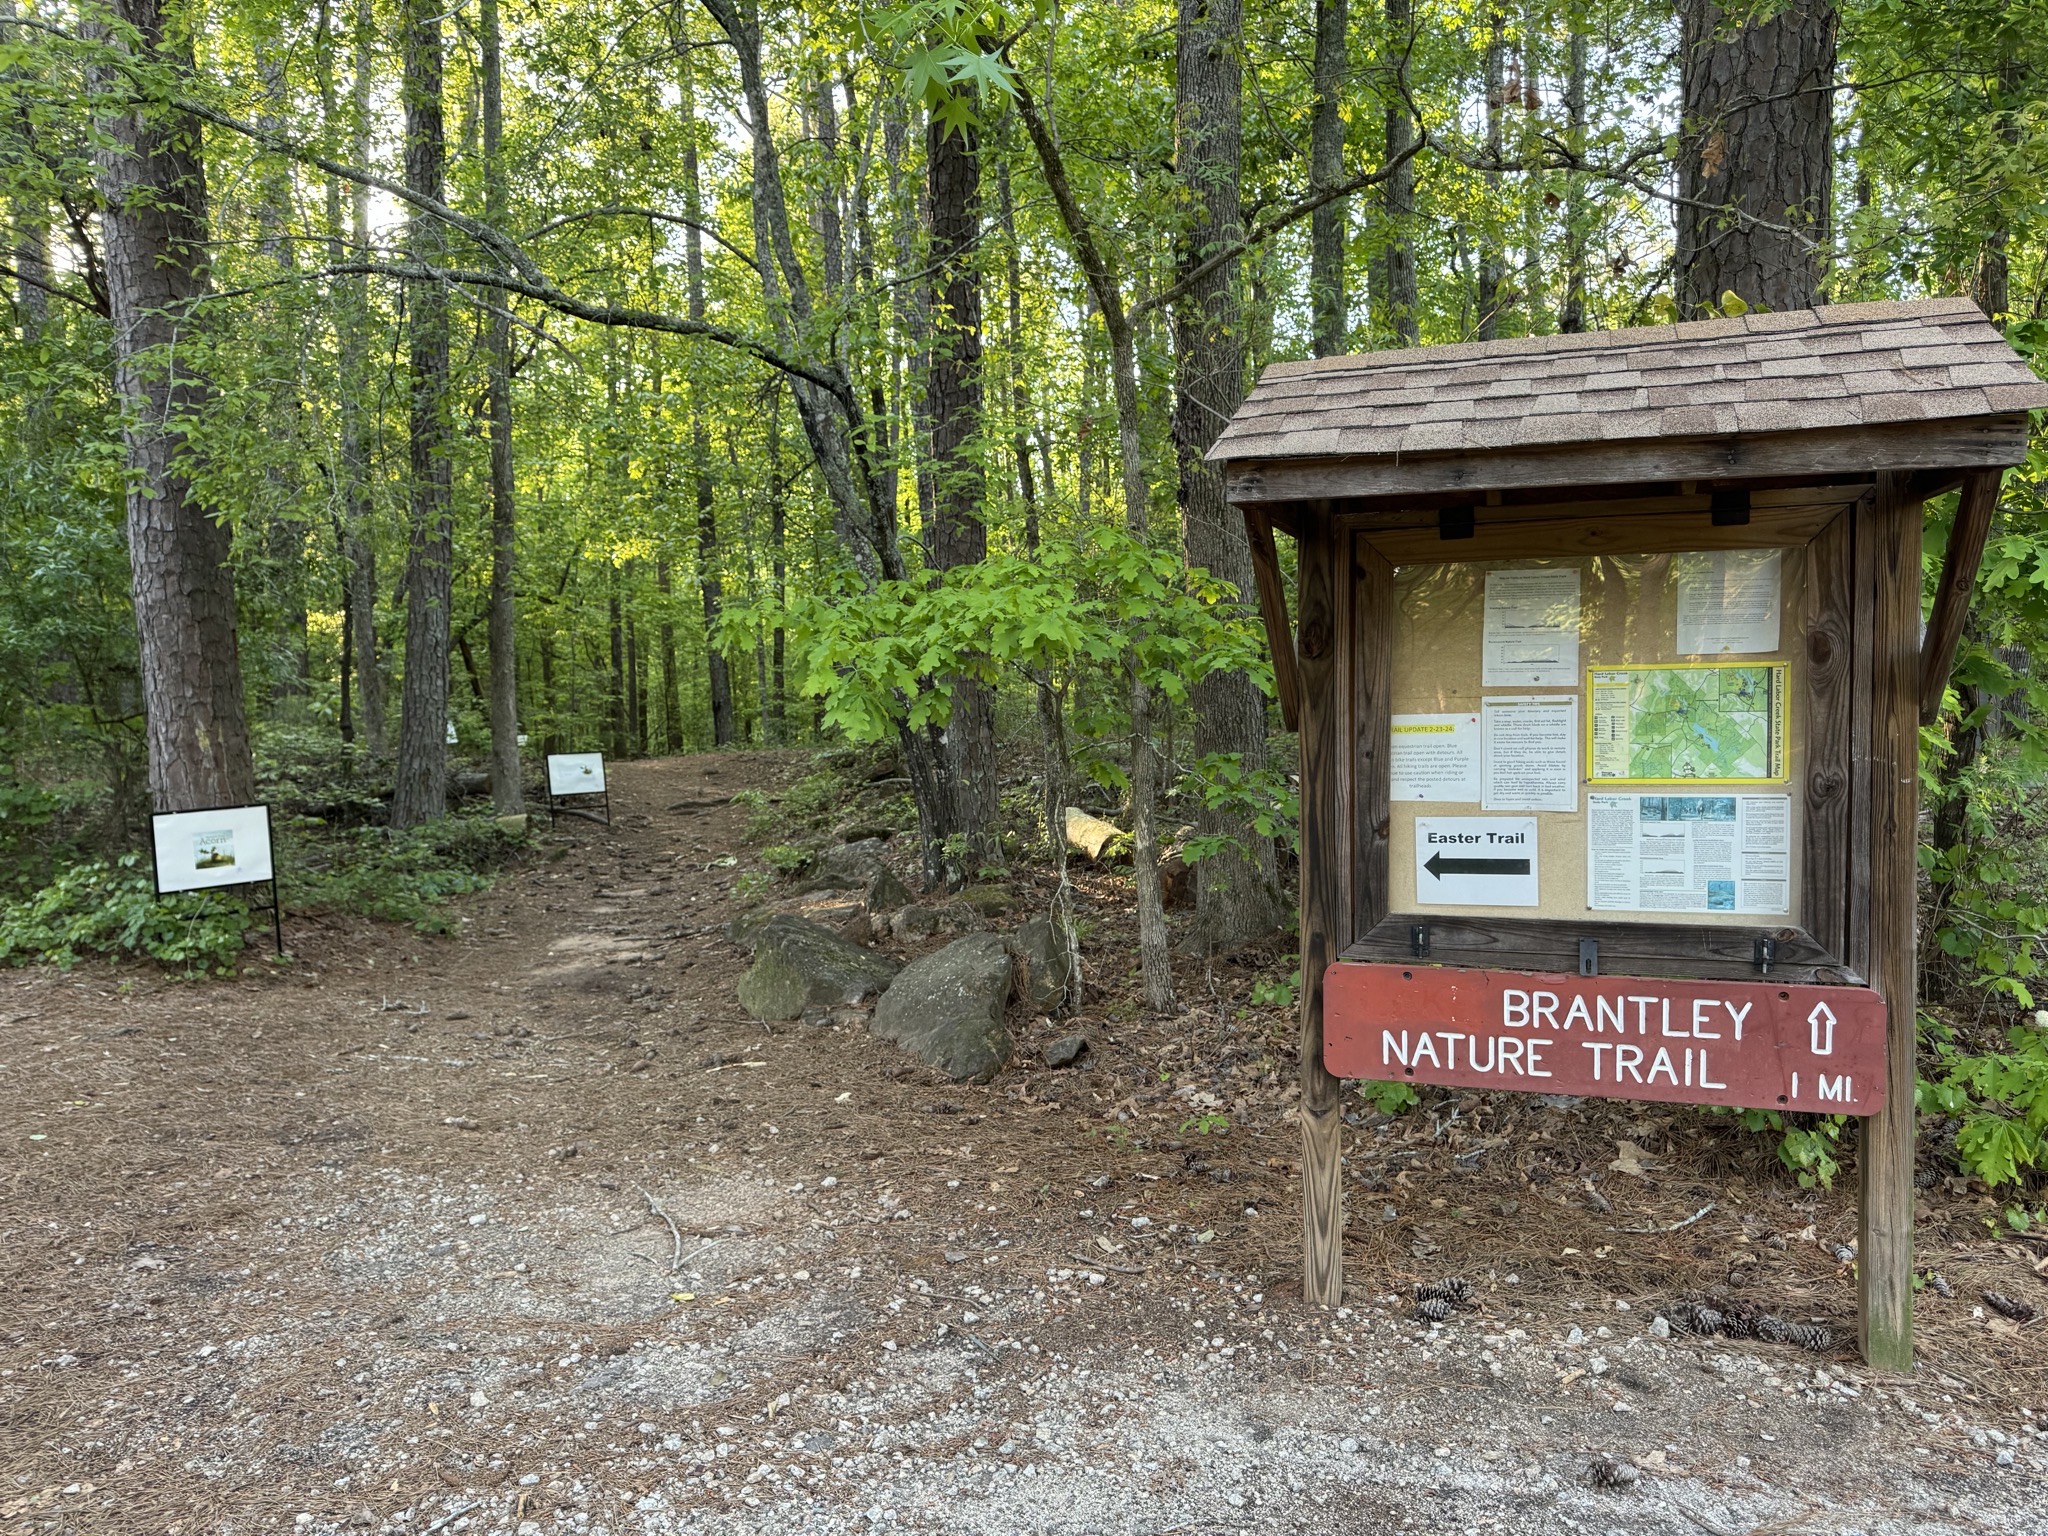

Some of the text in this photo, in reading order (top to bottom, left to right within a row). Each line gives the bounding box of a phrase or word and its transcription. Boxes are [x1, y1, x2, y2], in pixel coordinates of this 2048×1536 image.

[200, 836, 227, 846] Acorn
[1428, 832, 1525, 844] Easter Trail
[1503, 989, 1753, 1041] BRANTLEY
[1382, 1029, 1727, 1090] NATURE TRAIL
[1819, 1073, 1859, 1103] MI.
